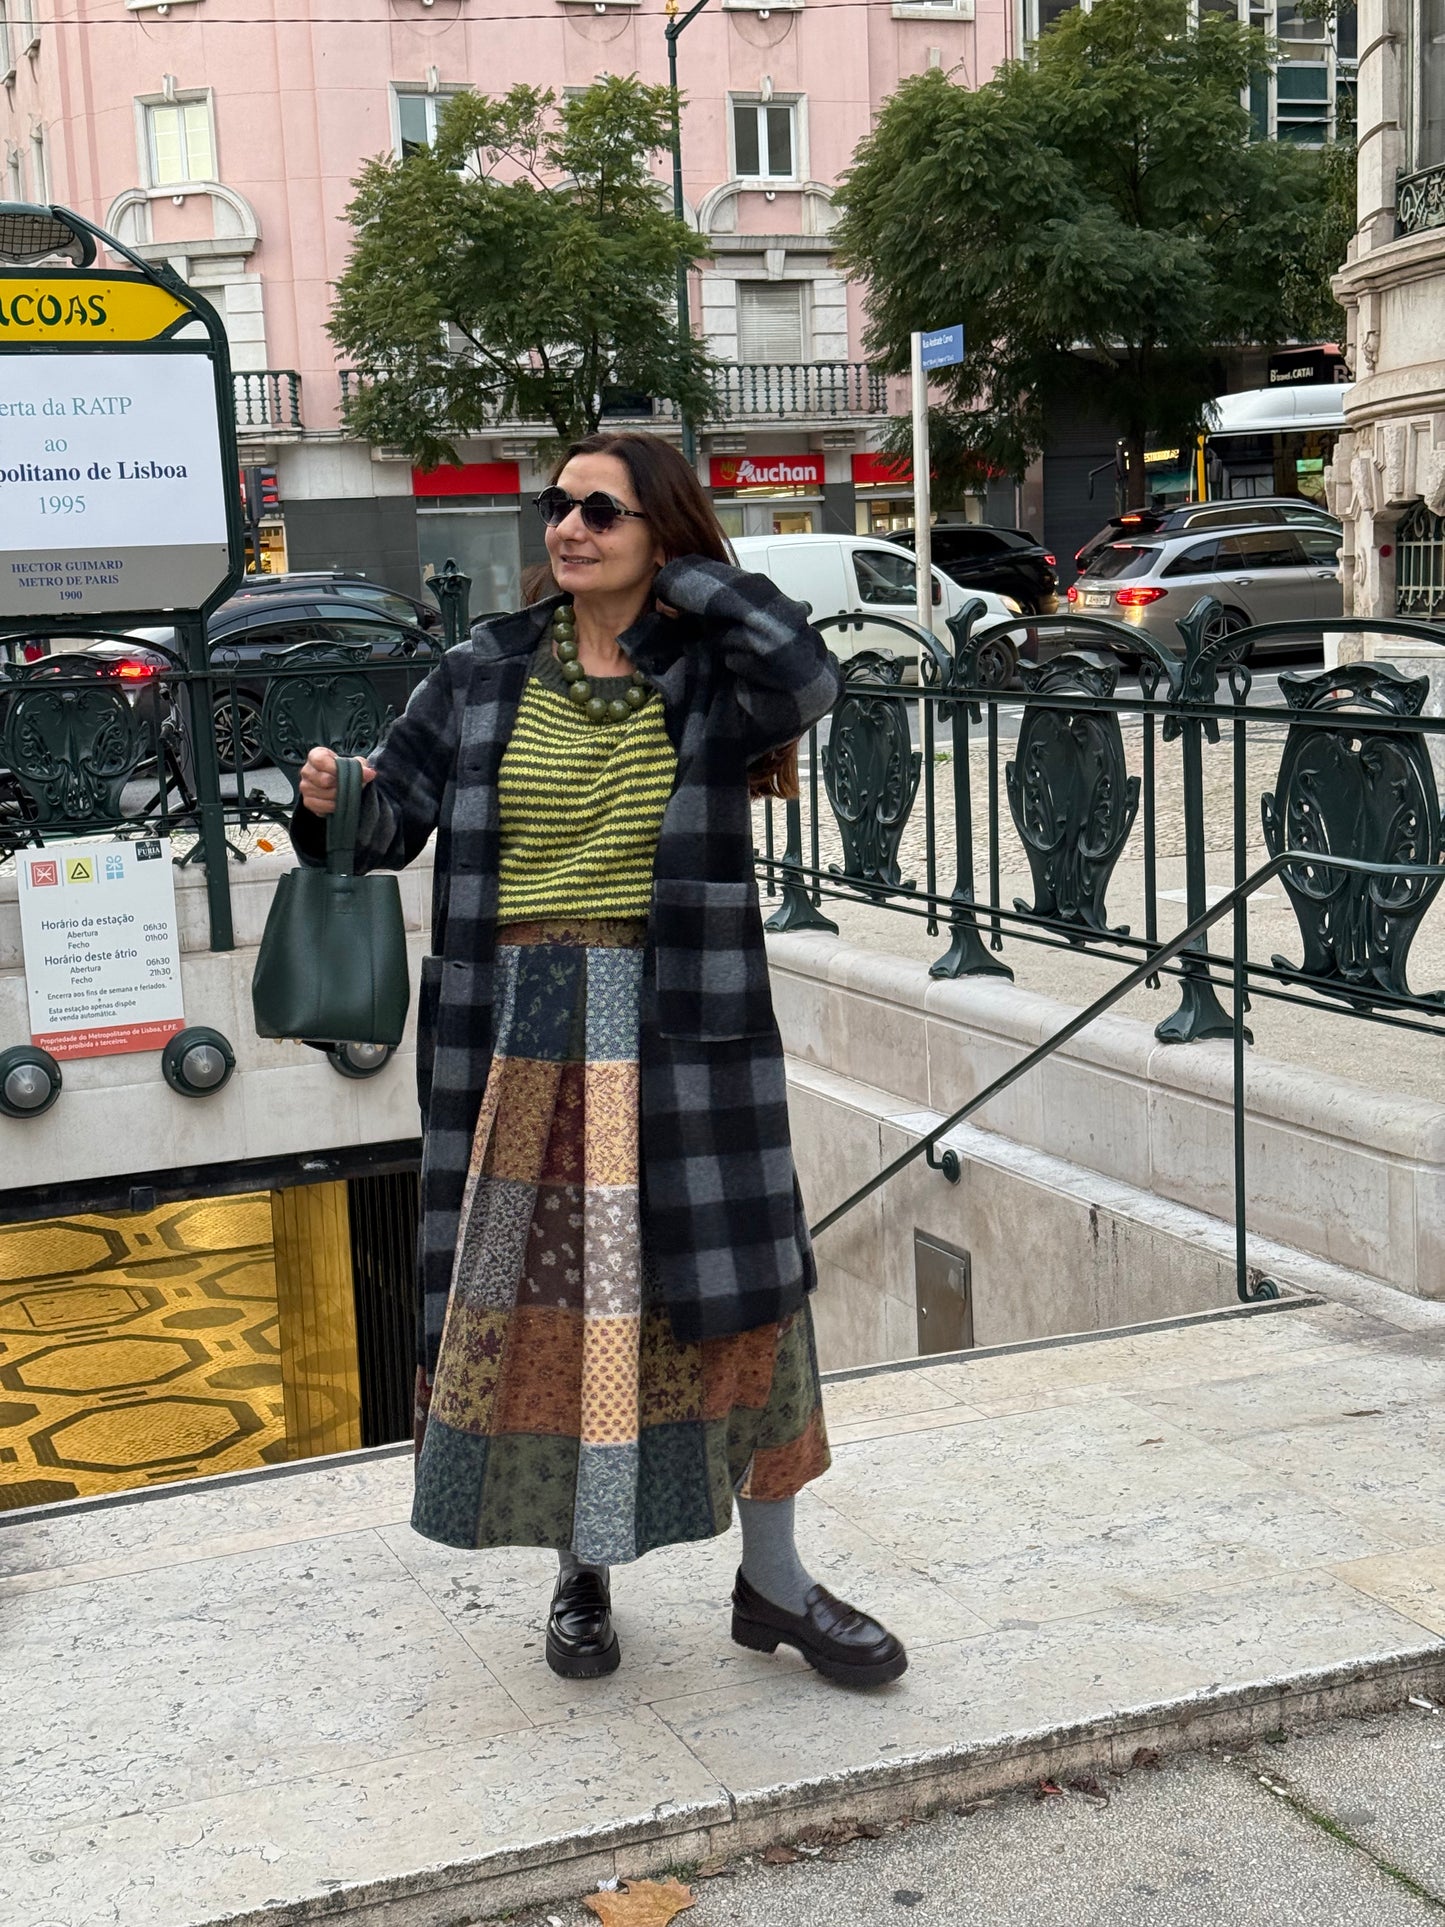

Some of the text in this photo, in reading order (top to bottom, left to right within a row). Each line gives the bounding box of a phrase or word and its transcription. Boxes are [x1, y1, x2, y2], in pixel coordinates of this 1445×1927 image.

[42, 398, 66, 416] da
[72, 397, 132, 415] RATP
[44, 438, 67, 452] ao
[87, 462, 112, 480] de
[117, 461, 188, 479] Lisboa
[736, 460, 817, 483] Auchan
[38, 495, 86, 514] 1995
[11, 560, 123, 573] HECTOR GUIMARD
[18, 574, 119, 588] METRO DE PARIS
[60, 591, 82, 600] 1900
[41, 913, 135, 930] Horário da estação
[143, 922, 168, 931] 06h30
[67, 930, 98, 939] Abertura
[145, 933, 168, 942] 01h00
[68, 941, 90, 950] Fecho
[44, 948, 138, 966] Horário deste átrio
[146, 957, 170, 966] 06h30
[70, 965, 101, 974] Abertura
[149, 967, 171, 977] 21h30
[71, 976, 93, 985] Fecho
[47, 992, 72, 1000] Encerra
[108, 986, 133, 994] semana
[64, 1004, 89, 1013] estação
[90, 1003, 113, 1011] apenas
[59, 1013, 79, 1021] venda
[40, 1035, 77, 1045] Propriedade
[88, 1030, 130, 1039] Metropolitano
[68, 1041, 94, 1051] proibida
